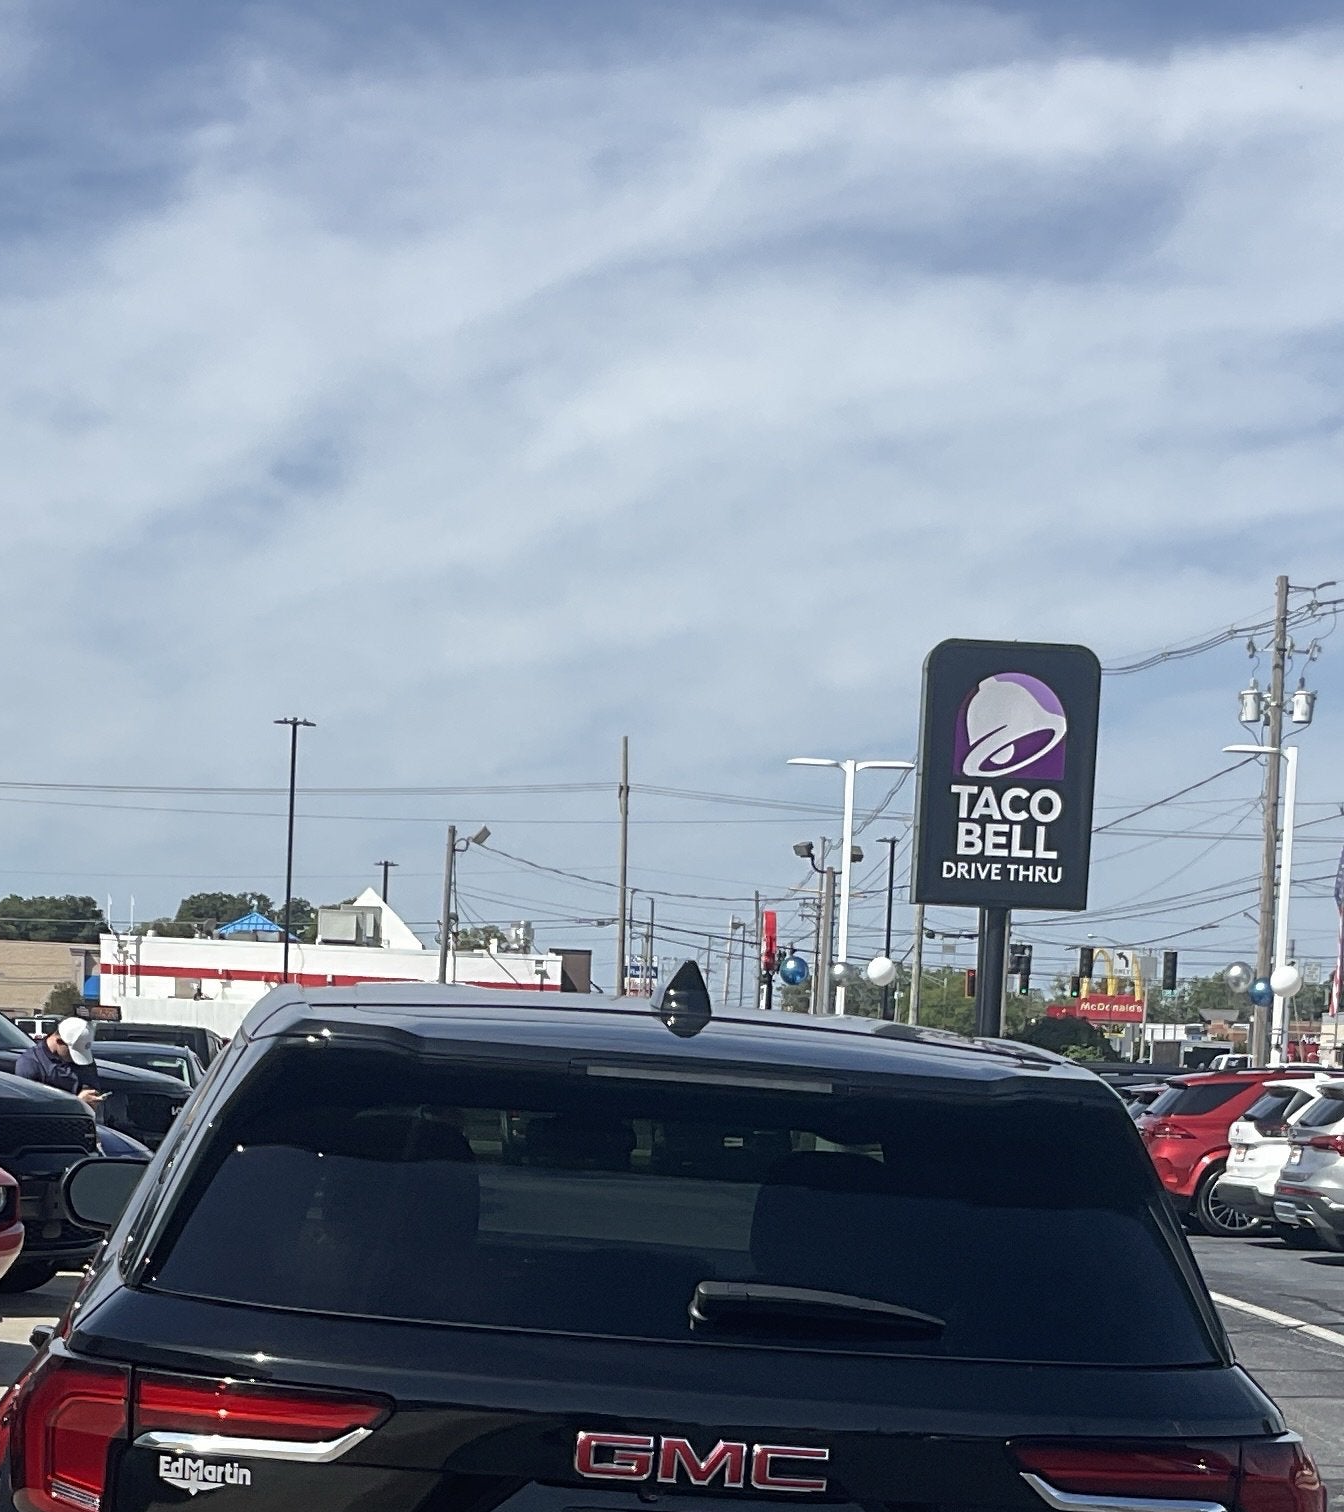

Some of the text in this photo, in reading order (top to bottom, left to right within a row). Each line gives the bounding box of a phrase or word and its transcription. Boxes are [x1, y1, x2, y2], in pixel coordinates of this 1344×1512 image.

[951, 785, 1062, 822] TACO
[957, 822, 1057, 859] BELL
[942, 861, 1063, 883] DRIVE THRU
[1080, 1002, 1142, 1013] McDonald's
[159, 1455, 251, 1485] EdMartin
[575, 1431, 830, 1492] GMC
